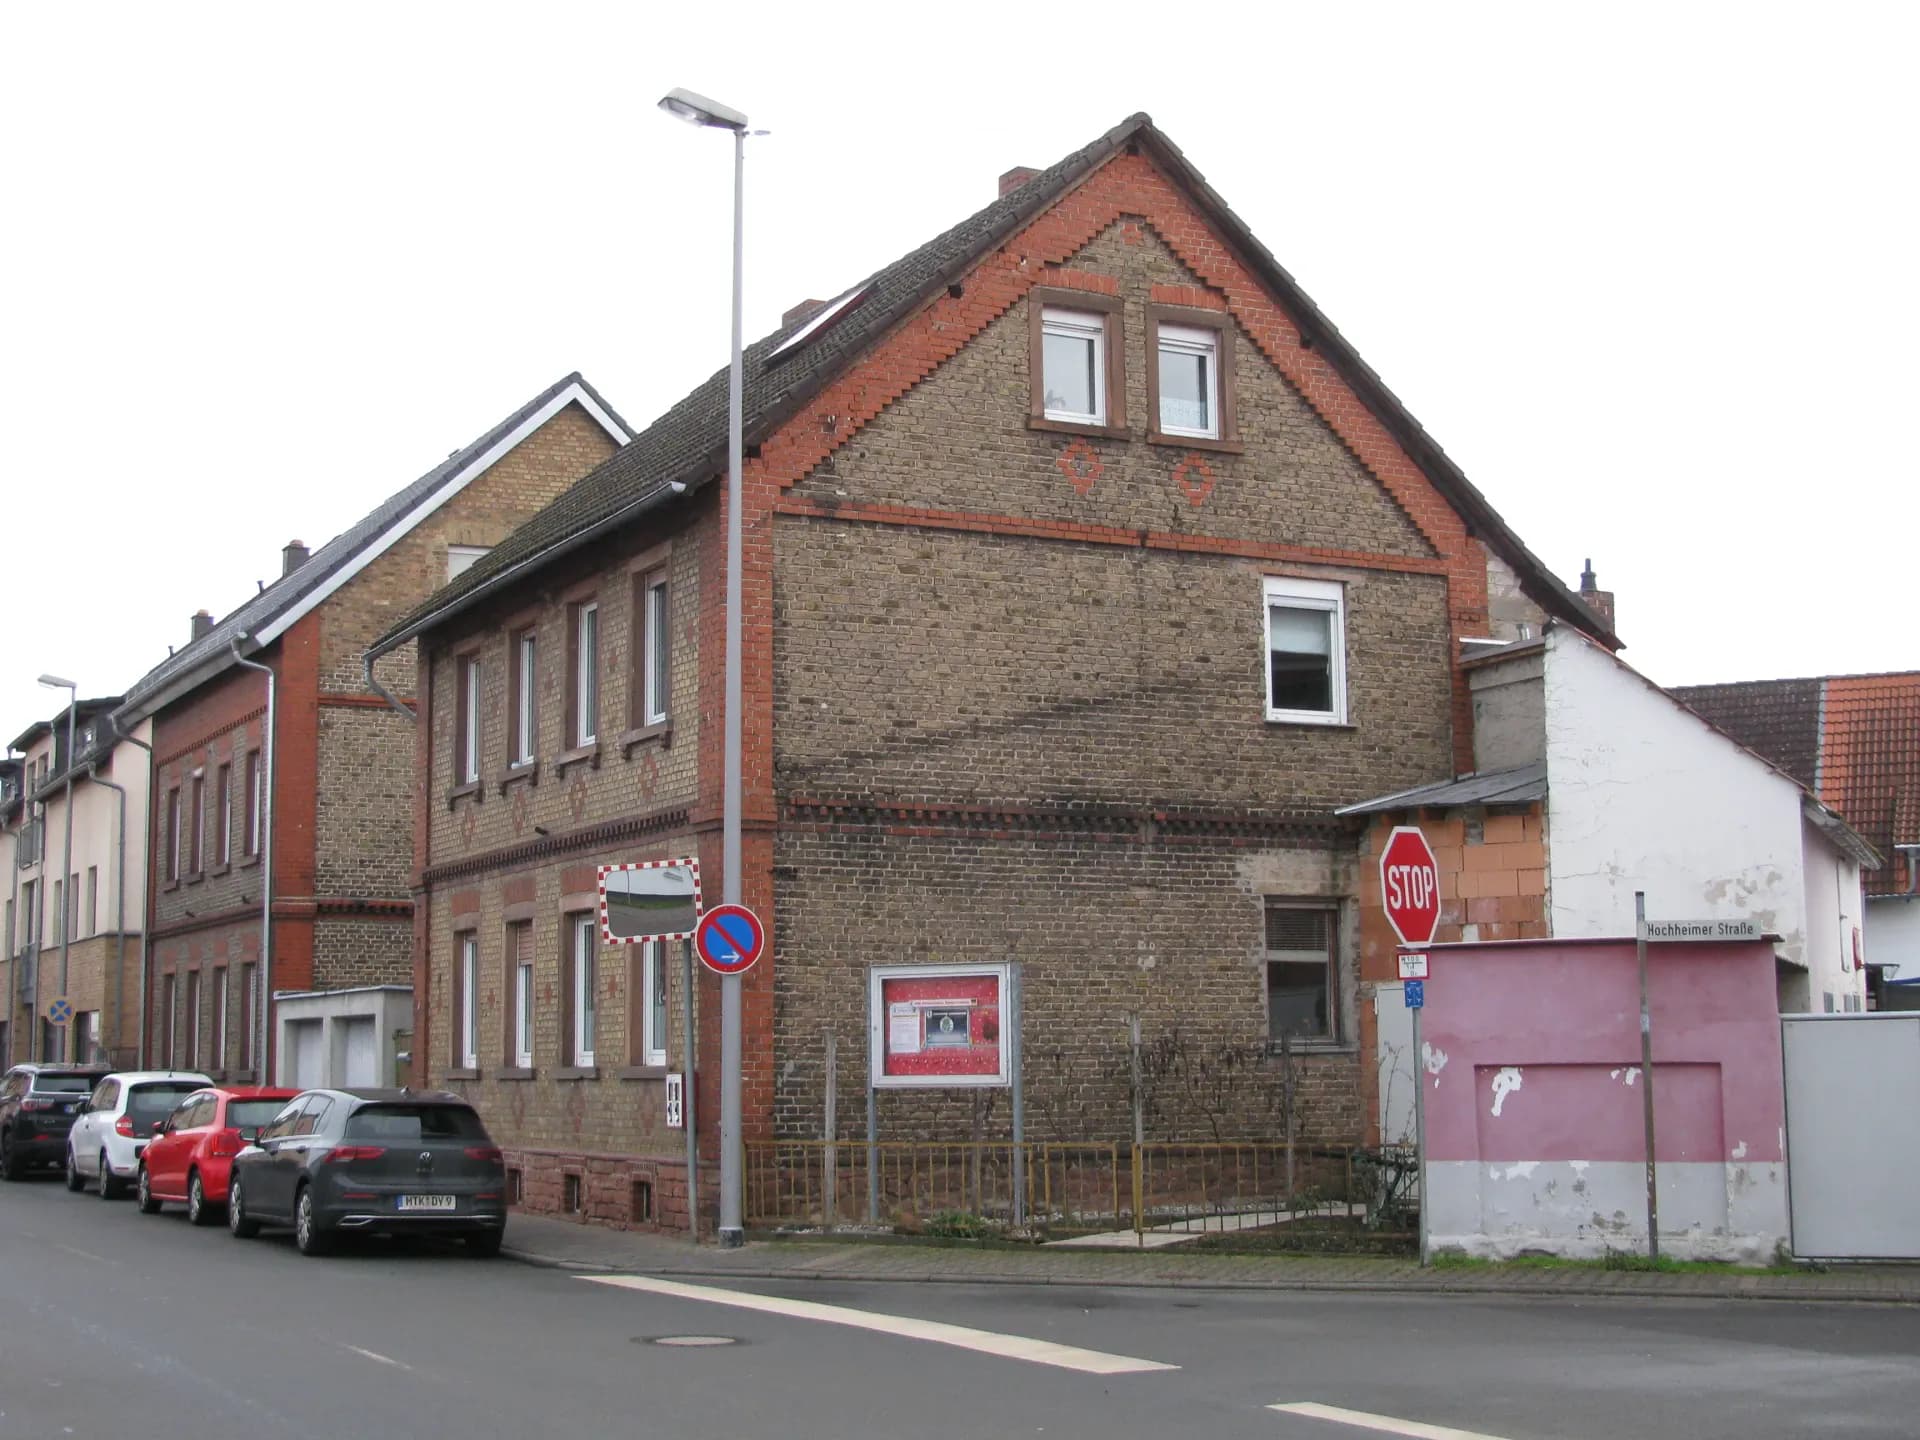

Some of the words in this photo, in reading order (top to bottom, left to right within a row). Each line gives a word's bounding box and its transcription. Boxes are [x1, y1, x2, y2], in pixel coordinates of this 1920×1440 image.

[1388, 864, 1433, 910] STOP
[1647, 922, 1713, 936] Hochheimer
[1718, 922, 1754, 935] Straße
